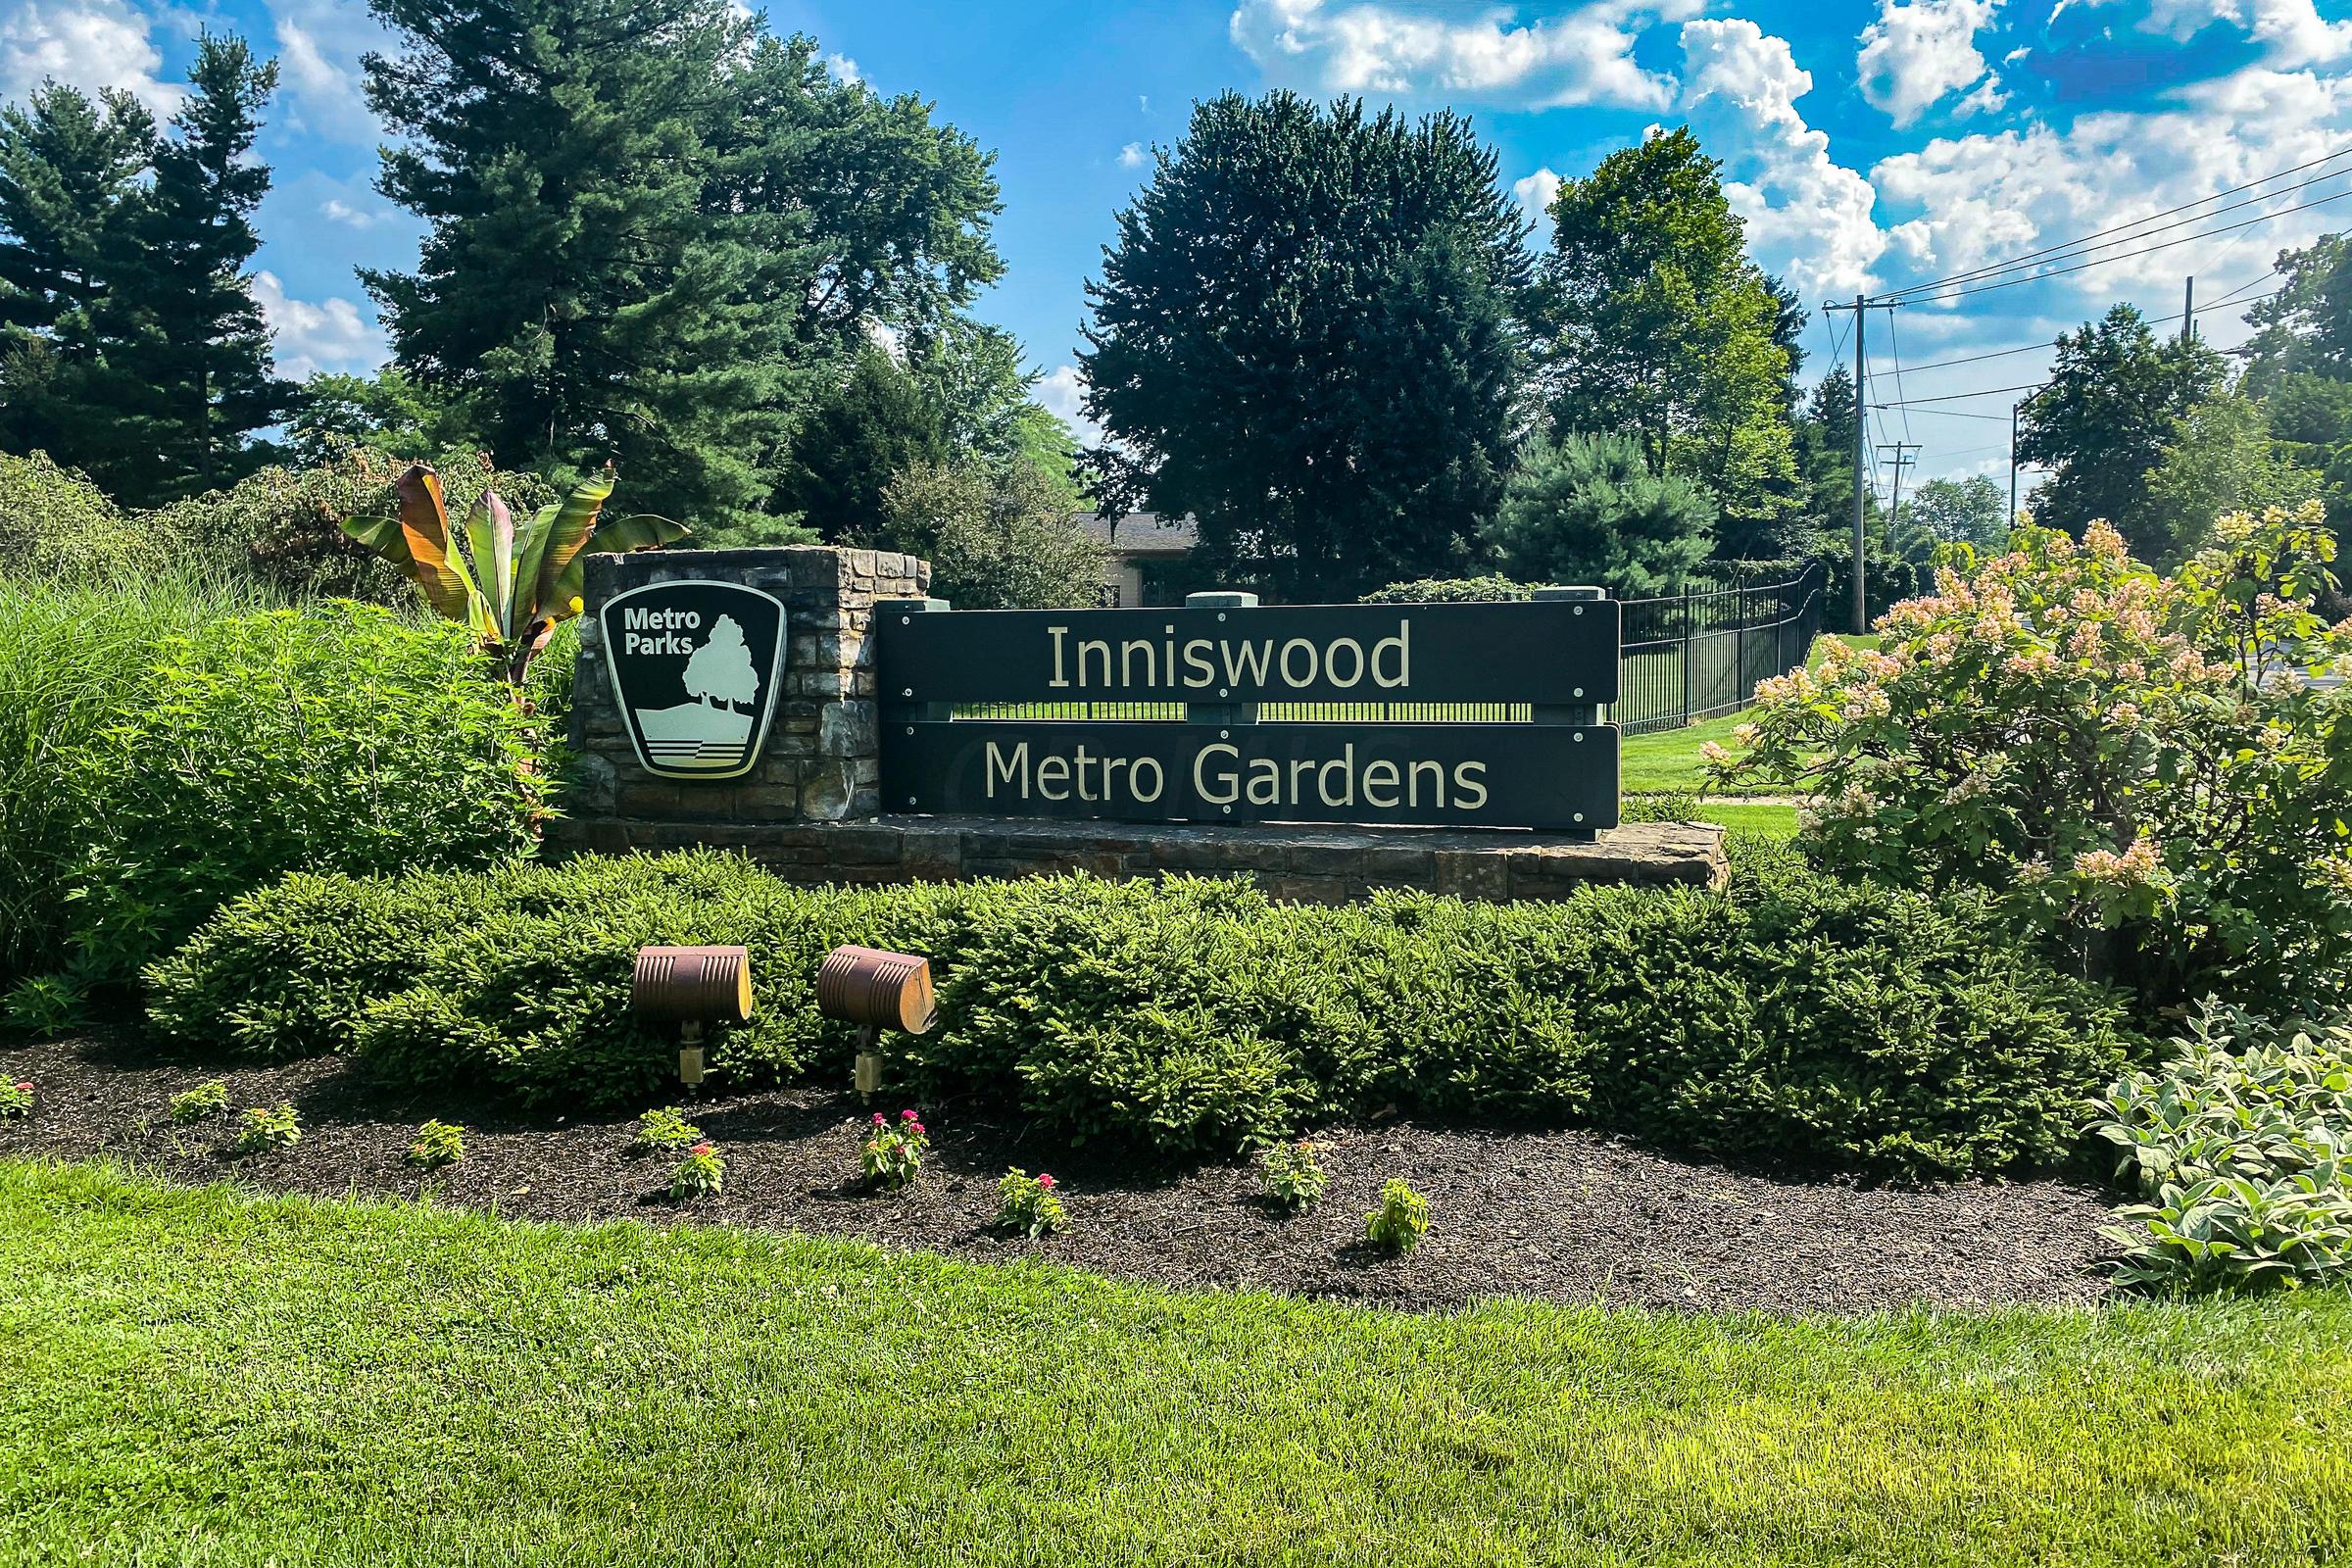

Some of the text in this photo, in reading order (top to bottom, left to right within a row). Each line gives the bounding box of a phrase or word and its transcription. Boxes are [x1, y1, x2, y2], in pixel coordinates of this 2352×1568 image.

[623, 608, 701, 630] Metro
[624, 630, 694, 656] Parks
[1048, 618, 1409, 688] Inniswood
[986, 742, 1488, 809] Metro Gardens
